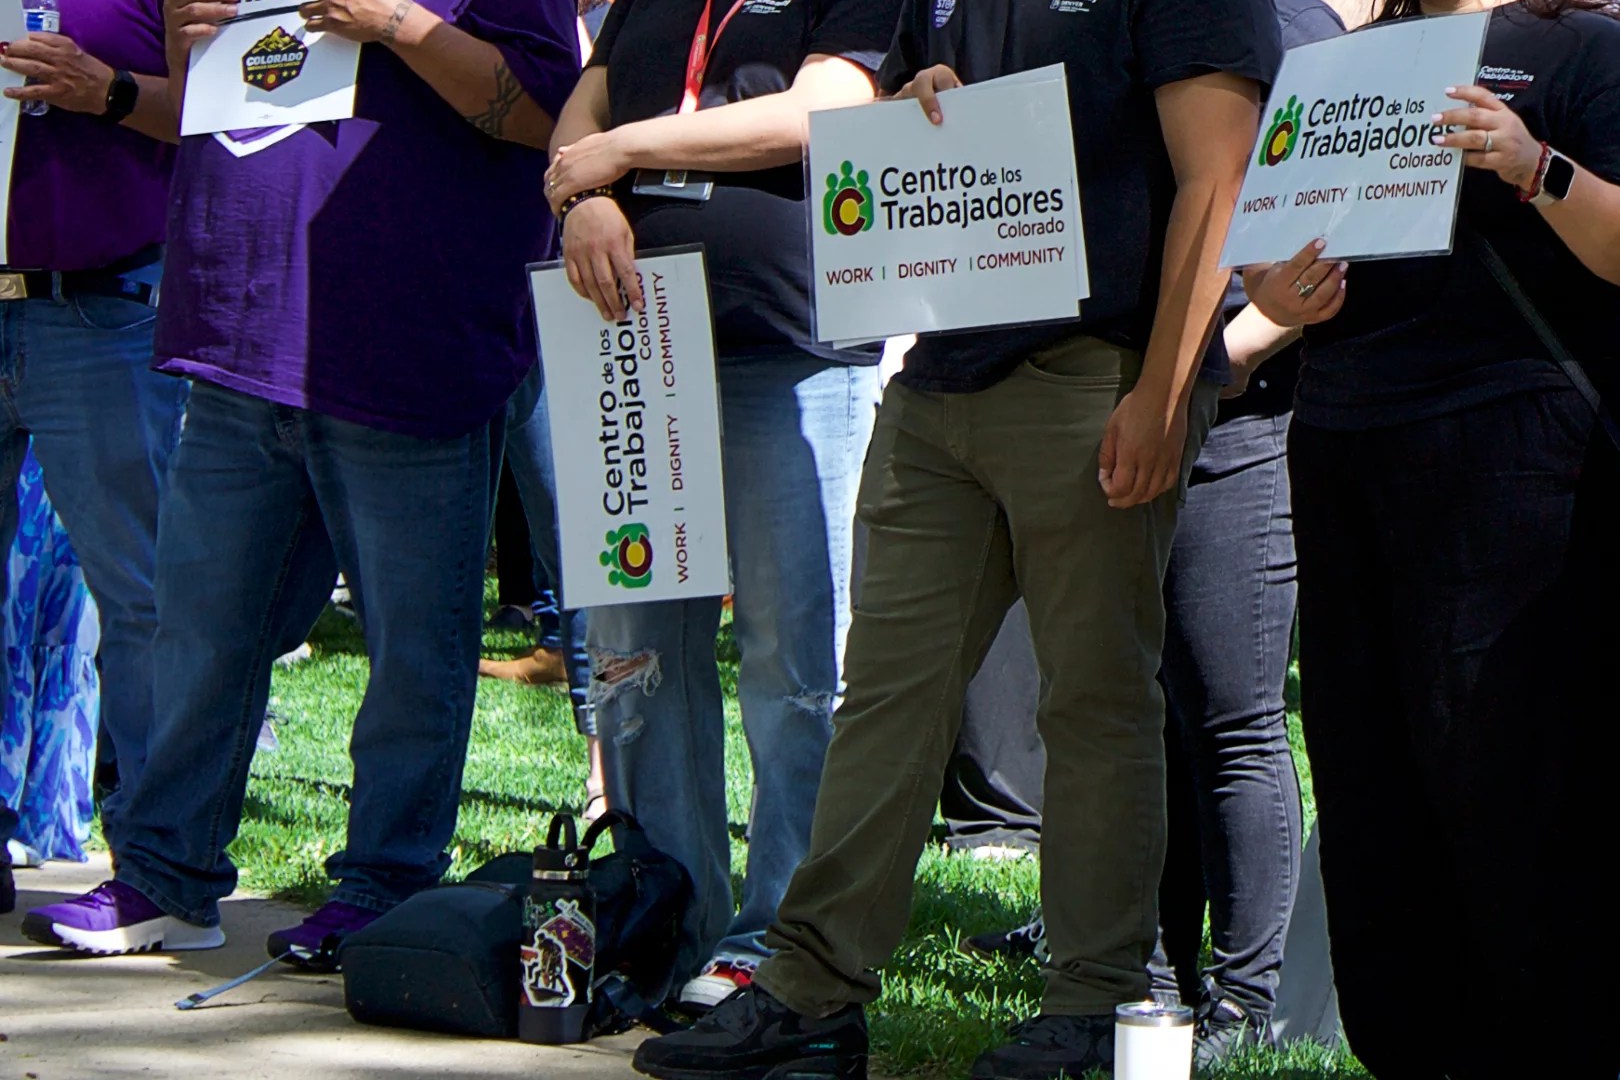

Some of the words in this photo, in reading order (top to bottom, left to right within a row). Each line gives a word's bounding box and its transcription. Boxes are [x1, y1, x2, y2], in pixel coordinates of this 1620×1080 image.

[246, 52, 303, 67] COLORADO
[1308, 93, 1385, 128] Centro
[1386, 100, 1402, 117] de
[1404, 98, 1425, 114] los
[1389, 150, 1453, 170] Colorado
[880, 163, 976, 197] Centro
[980, 169, 997, 186] de
[1002, 167, 1022, 184] los
[1243, 195, 1278, 214] WORK
[1294, 187, 1349, 207] DIGNITY
[1364, 180, 1448, 201] COMMUNITY
[880, 187, 1064, 230] Trabajadores
[997, 217, 1065, 239] Colorado
[826, 267, 874, 286] WORK
[898, 258, 957, 279] DIGNITY
[977, 246, 1065, 270] COMMUNITY
[599, 328, 611, 357] los
[651, 271, 675, 388] COMMUNITY
[601, 362, 614, 385] de
[614, 277, 649, 515] Trabajador
[600, 390, 625, 517] Centro
[667, 414, 683, 491] DIGNITY
[675, 522, 689, 584] WORK
